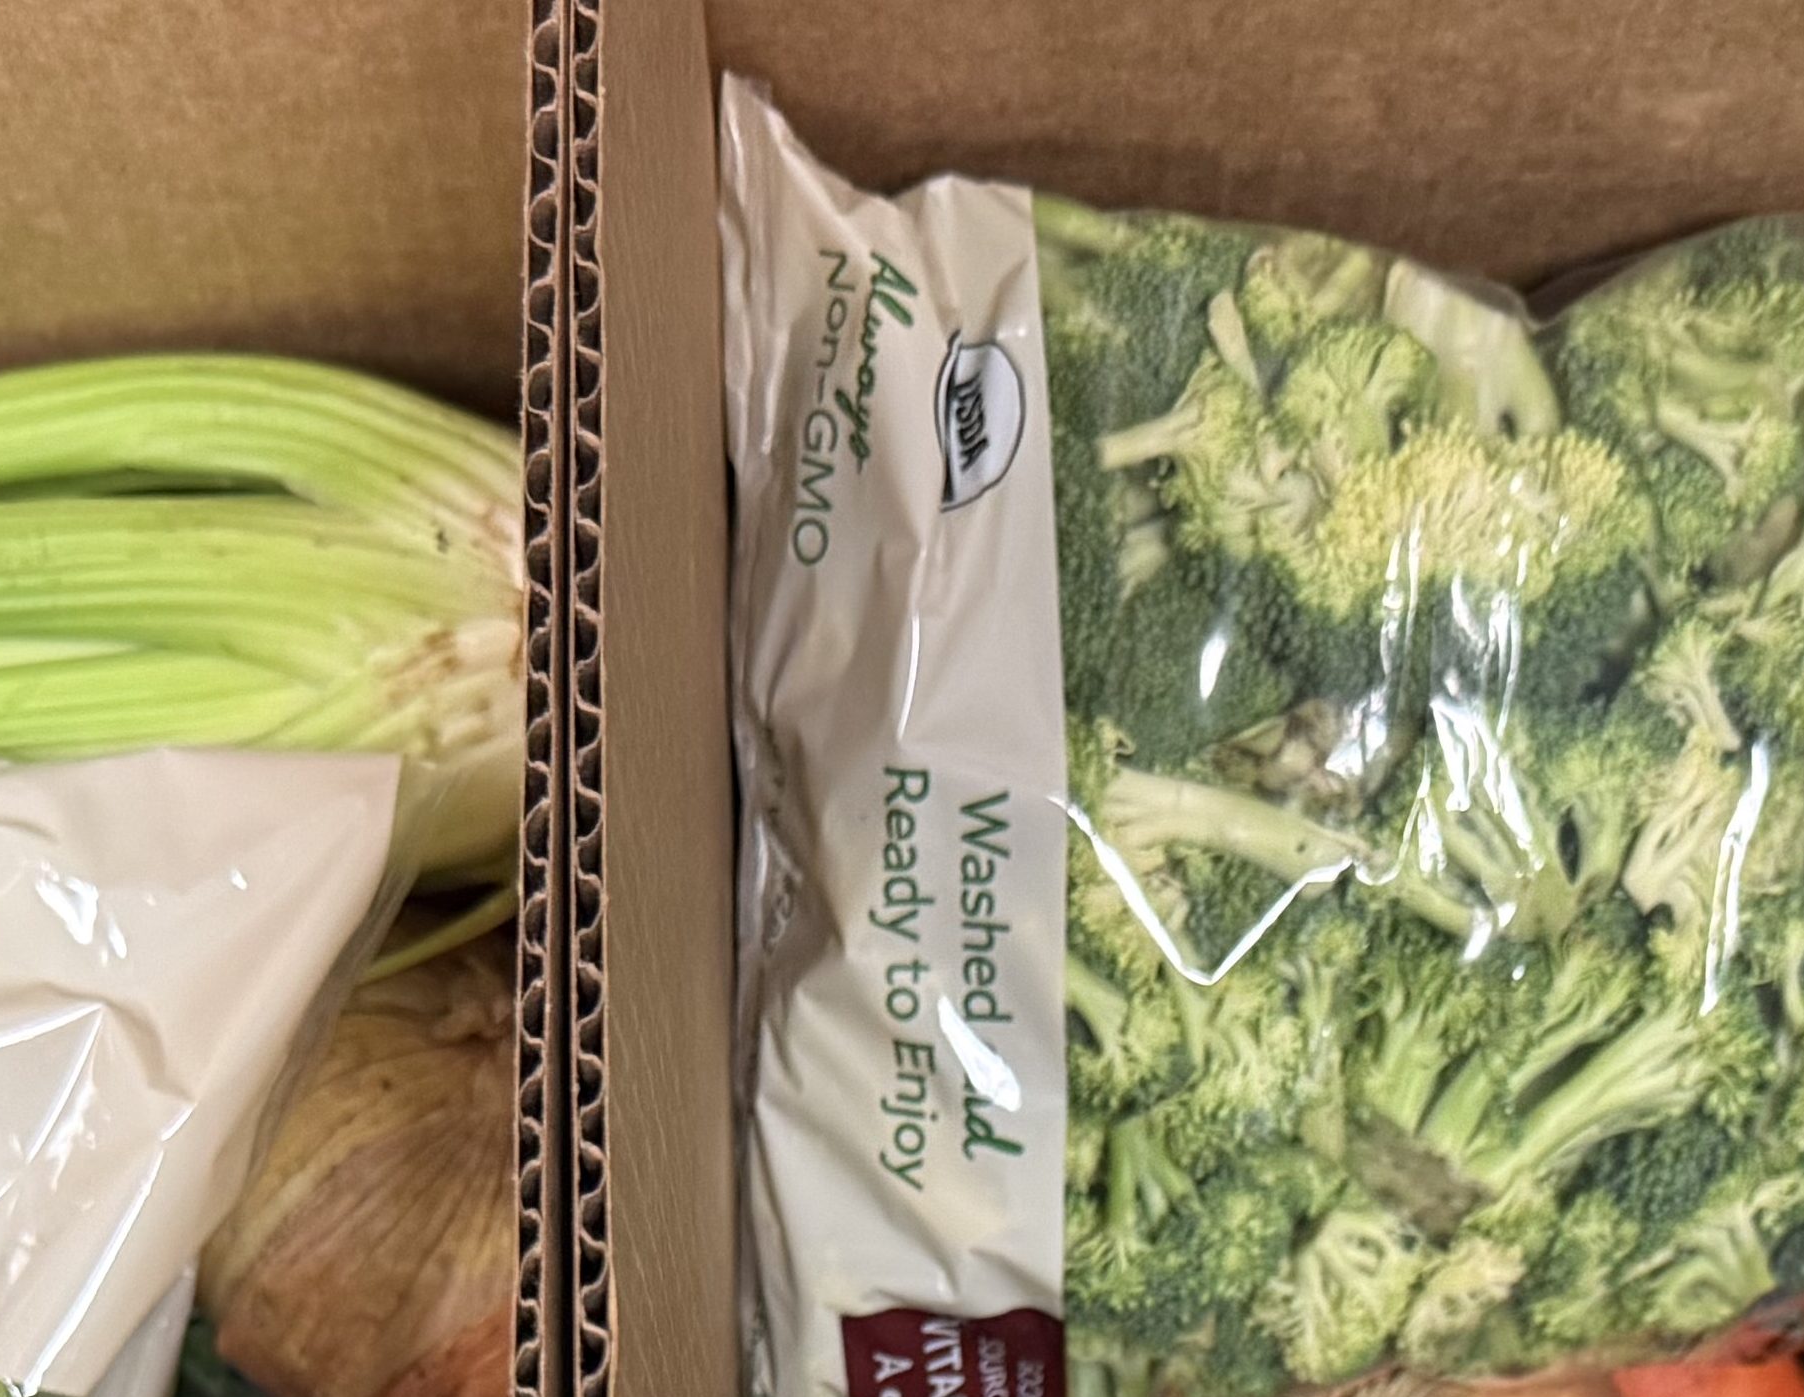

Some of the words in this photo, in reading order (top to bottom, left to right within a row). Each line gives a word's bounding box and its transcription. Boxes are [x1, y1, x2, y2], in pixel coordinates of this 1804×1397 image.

[793, 250, 856, 566] Non-GMO
[837, 252, 917, 472] Always
[948, 373, 989, 471] USDA
[870, 768, 933, 941] Ready
[957, 791, 1013, 1024] Washed
[884, 959, 929, 1020] to
[879, 1041, 937, 1192] Enjoy
[872, 1352, 913, 1382] A
